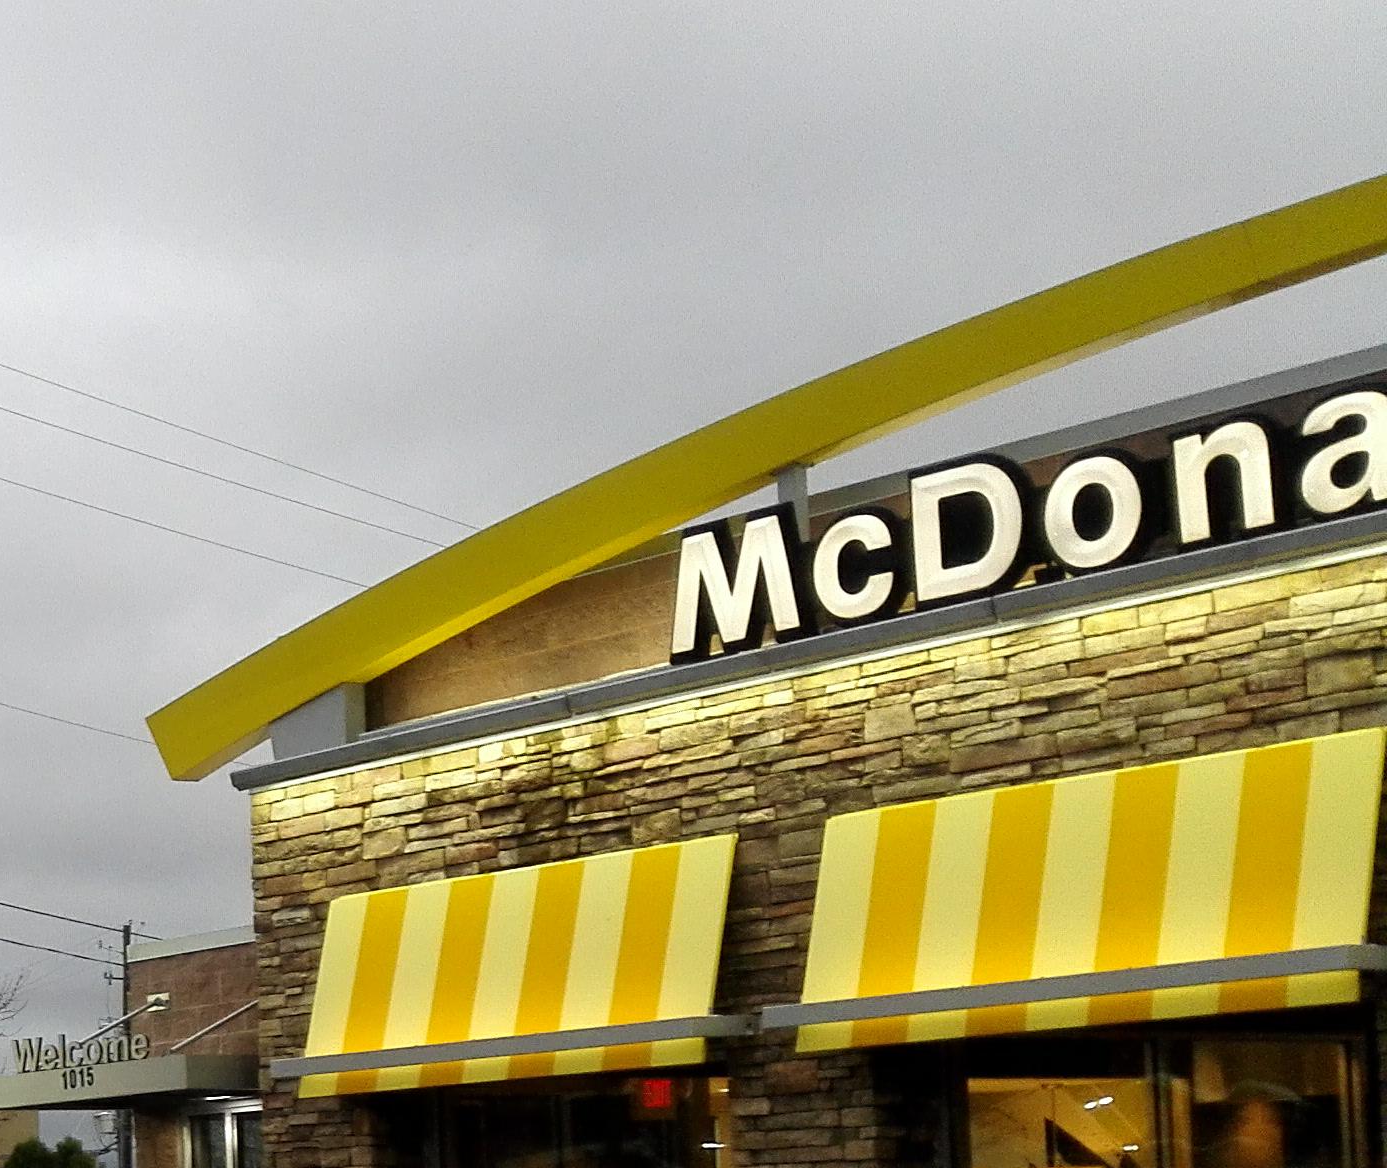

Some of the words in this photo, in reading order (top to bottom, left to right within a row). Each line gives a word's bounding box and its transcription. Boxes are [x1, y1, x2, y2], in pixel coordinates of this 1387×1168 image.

[671, 390, 1387, 655] McDona
[13, 1034, 149, 1073] Welcome
[62, 1067, 94, 1089] 1015
